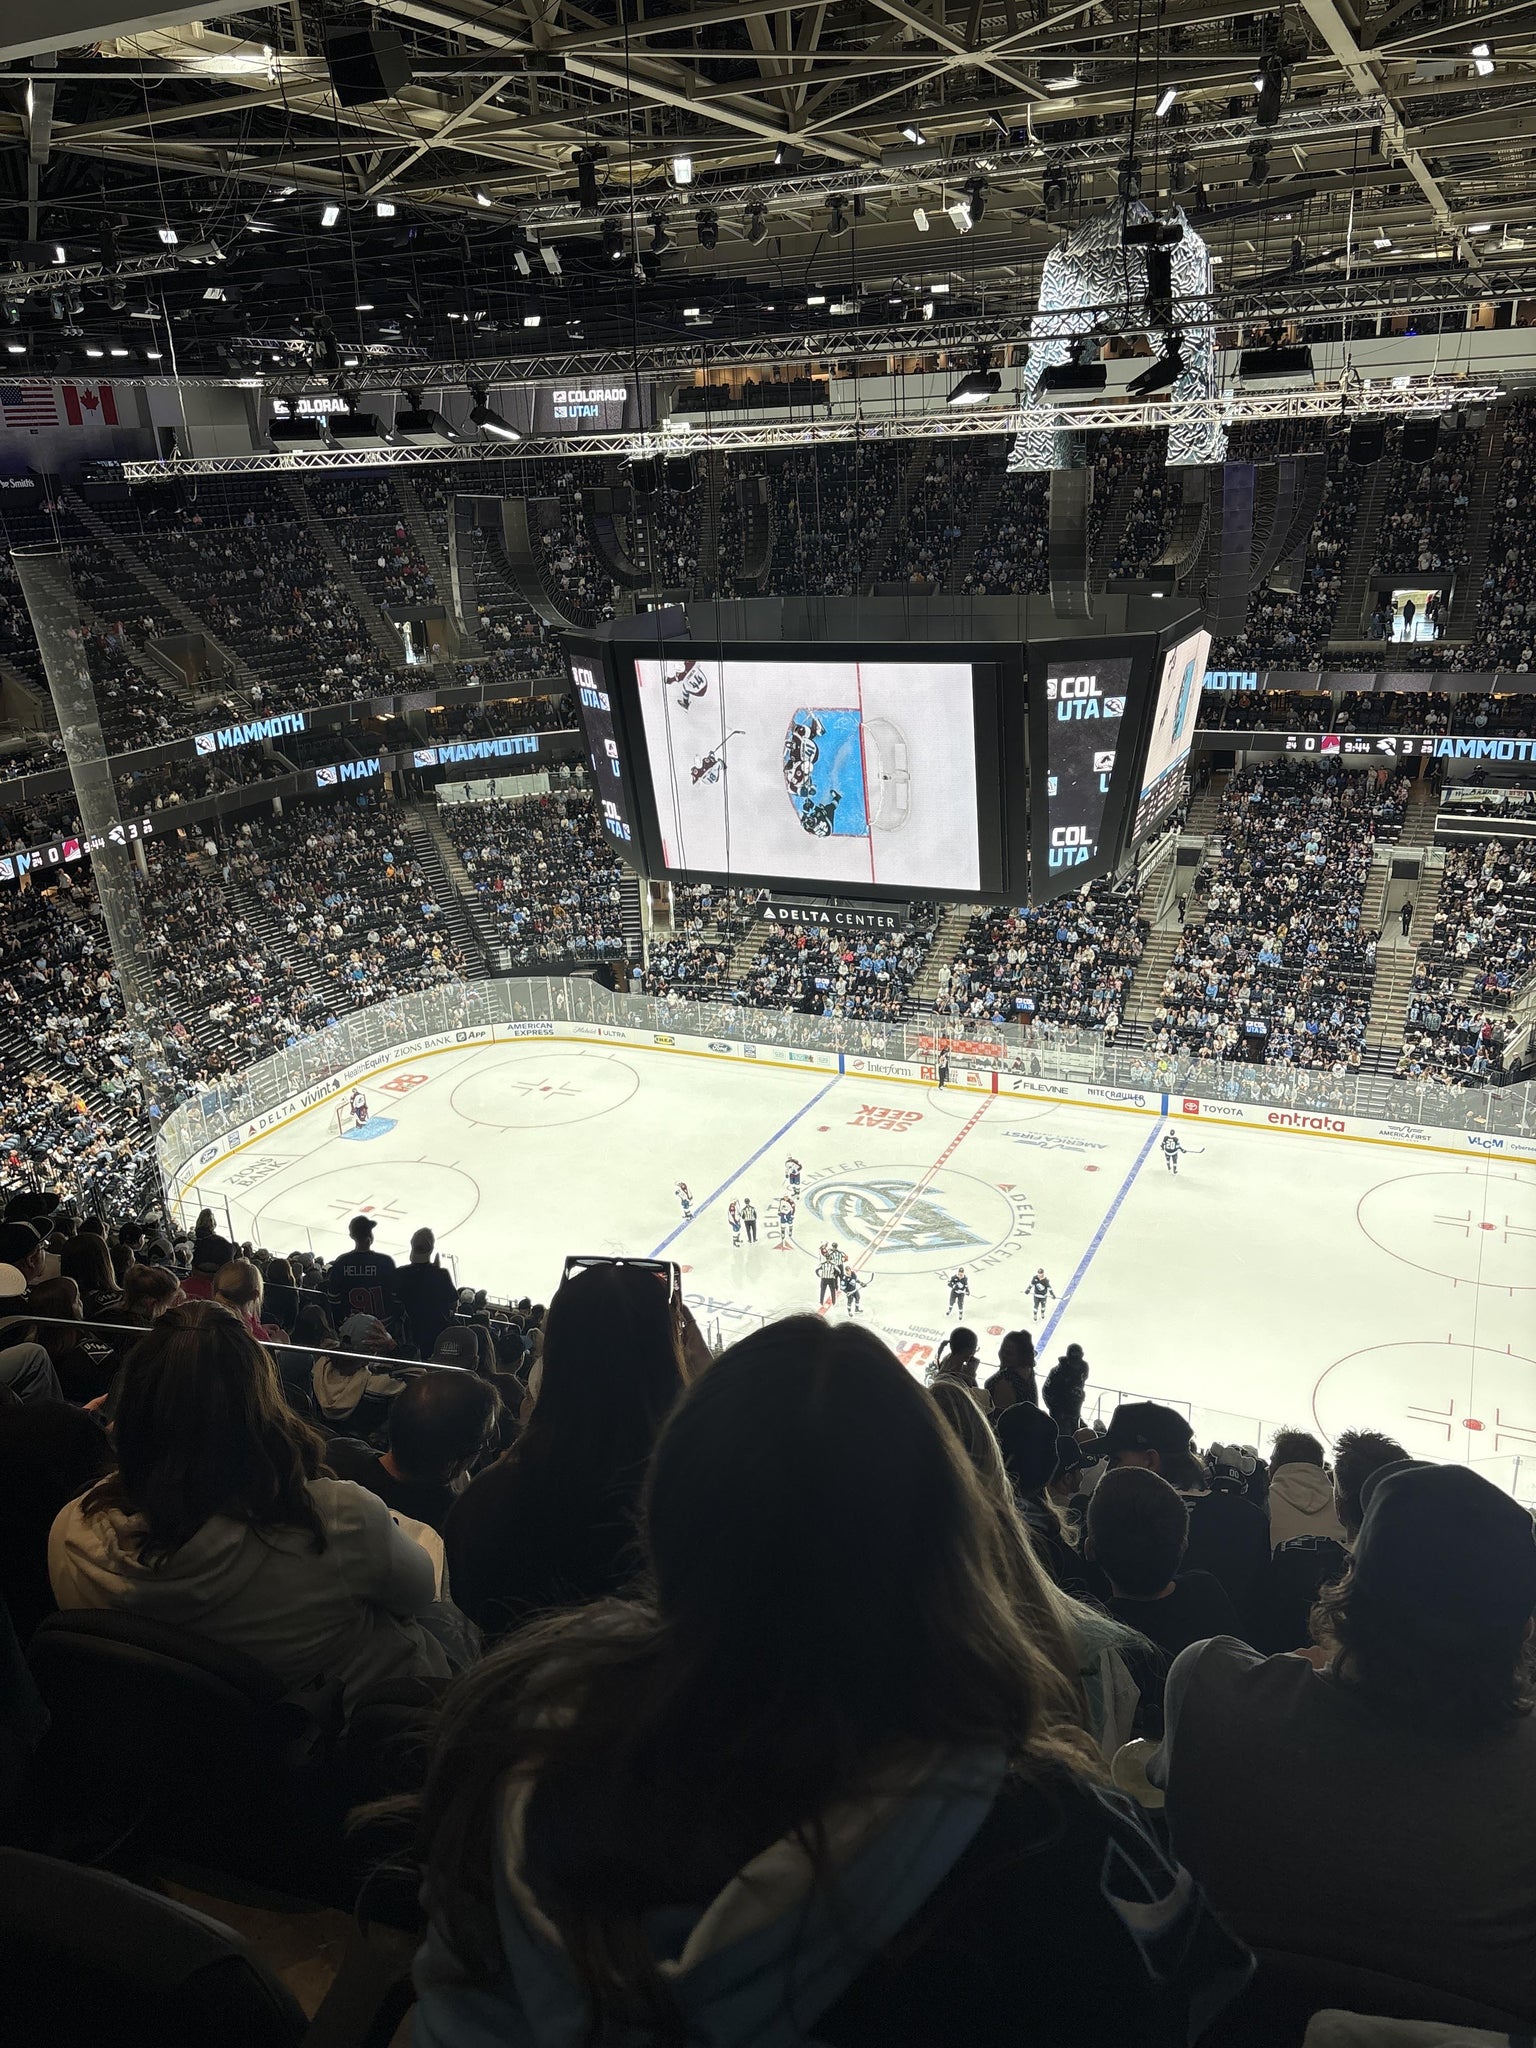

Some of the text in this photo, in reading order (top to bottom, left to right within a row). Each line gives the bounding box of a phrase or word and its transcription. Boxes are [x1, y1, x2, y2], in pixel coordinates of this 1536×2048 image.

[568, 389, 626, 402] COLORADO
[297, 399, 349, 413] OLORAD
[568, 404, 599, 417] UTAH
[578, 668, 597, 689] COL
[1060, 676, 1102, 699] COL
[580, 688, 600, 708] UTA
[1057, 699, 1100, 721] UTA
[217, 713, 305, 750] MAMMOTH
[438, 736, 538, 764] MAMMOTH
[1285, 741, 1297, 749] 24
[1304, 738, 1315, 751] 0
[1344, 742, 1370, 753] 9:44
[1402, 740, 1413, 753] 3
[48, 847, 59, 863] 0
[83, 837, 105, 854] 9:44
[128, 823, 138, 839] 3
[1052, 826, 1092, 847] COL
[1049, 846, 1089, 867] UTA
[779, 908, 895, 928] DELTA CENTER
[507, 1022, 553, 1031] AMERICAN
[514, 1029, 554, 1037] EXPRESS
[603, 1029, 626, 1038] ULTRA
[394, 1042, 422, 1058] ZIONS
[424, 1035, 452, 1048] BANK
[344, 1053, 390, 1081] HealthEquity
[867, 1060, 911, 1077] Interform
[1023, 1081, 1069, 1095] FILEVINE
[259, 1103, 296, 1129] DELTA
[855, 1104, 924, 1121] GEEK
[1203, 1104, 1243, 1117] TOYOTA
[846, 1116, 912, 1132] SEAT
[1267, 1112, 1345, 1133] entrata
[1002, 1131, 1043, 1141] FIRST
[1045, 1136, 1107, 1149] AMERICA
[1379, 1129, 1410, 1139] AMERICA
[1411, 1133, 1431, 1142] FIRST
[1165, 1141, 1175, 1150] 20
[222, 1156, 274, 1185] ZIONS
[237, 1159, 290, 1187] BANK
[934, 1193, 1035, 1280] DELTA CENTR
[343, 1265, 377, 1277] HELLER
[349, 1285, 385, 1314] 91
[908, 1324, 945, 1337] Health
